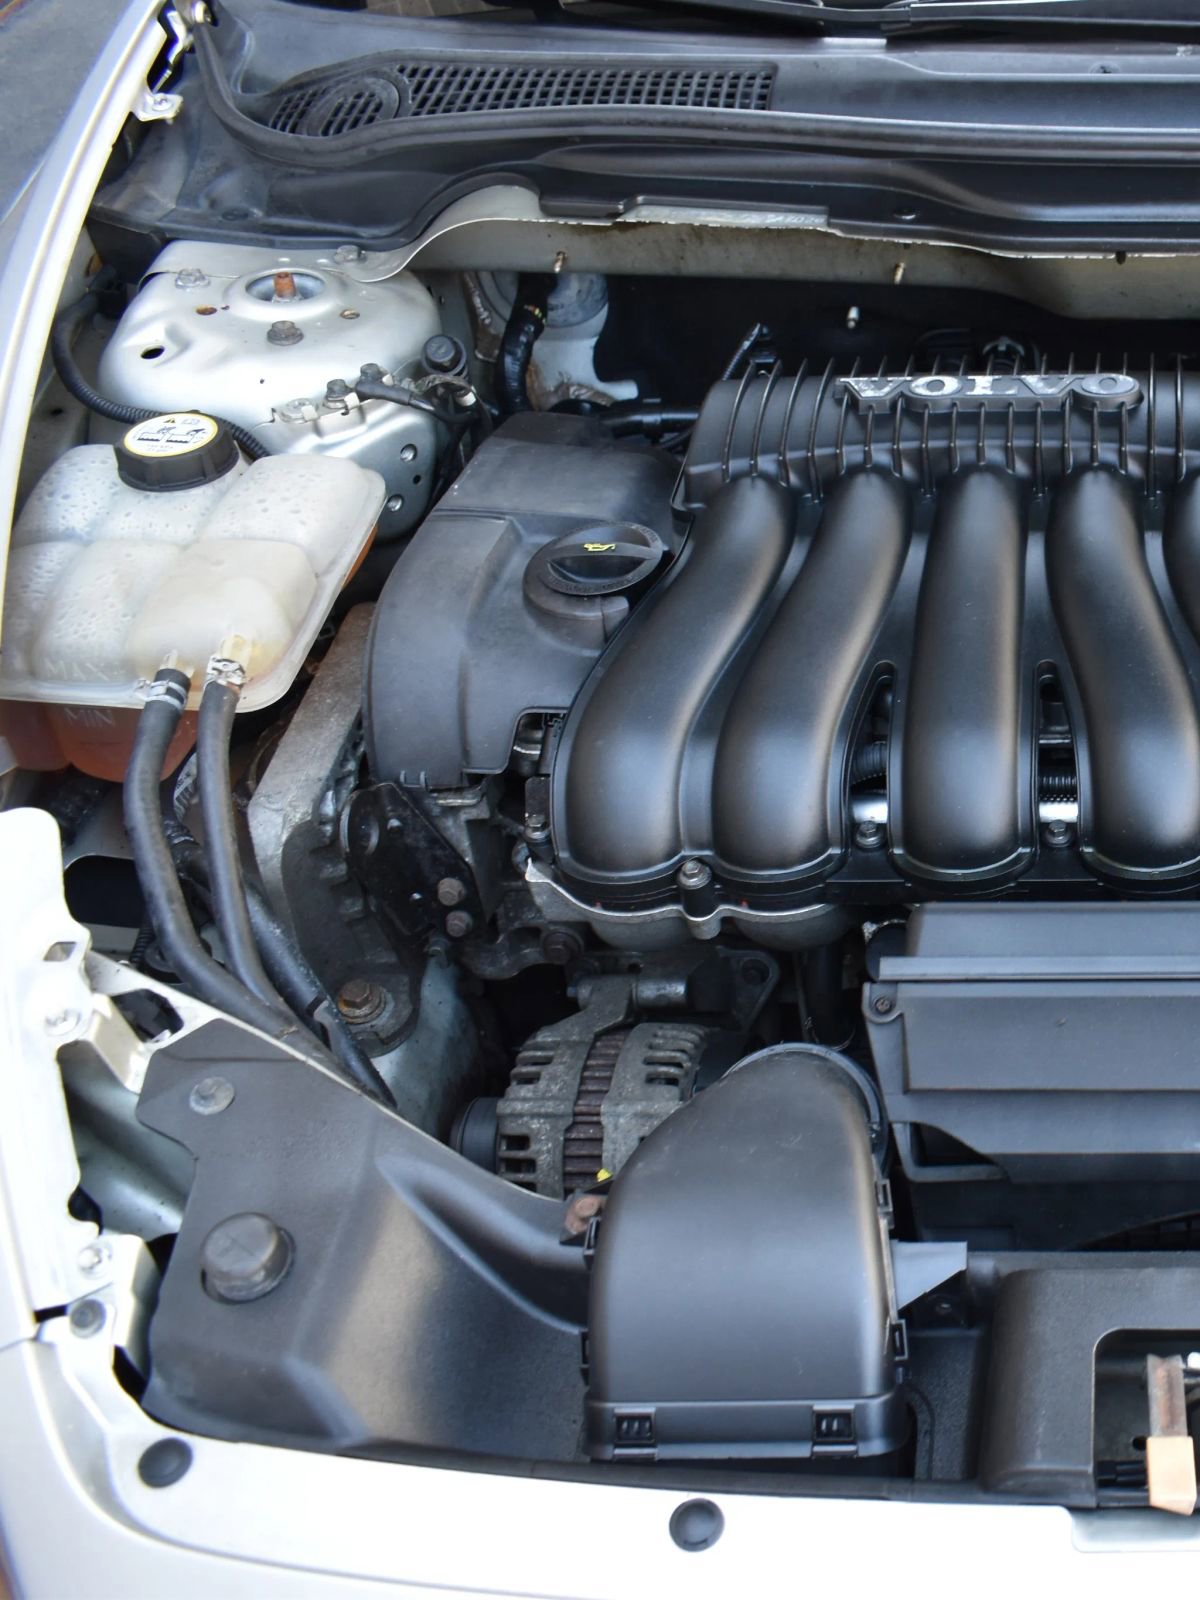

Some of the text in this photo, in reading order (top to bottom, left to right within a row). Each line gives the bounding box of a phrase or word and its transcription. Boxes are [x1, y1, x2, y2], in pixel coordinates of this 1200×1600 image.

[840, 373, 1139, 400] VOLVO
[44, 657, 110, 681] MAX
[64, 707, 116, 728] MIN
